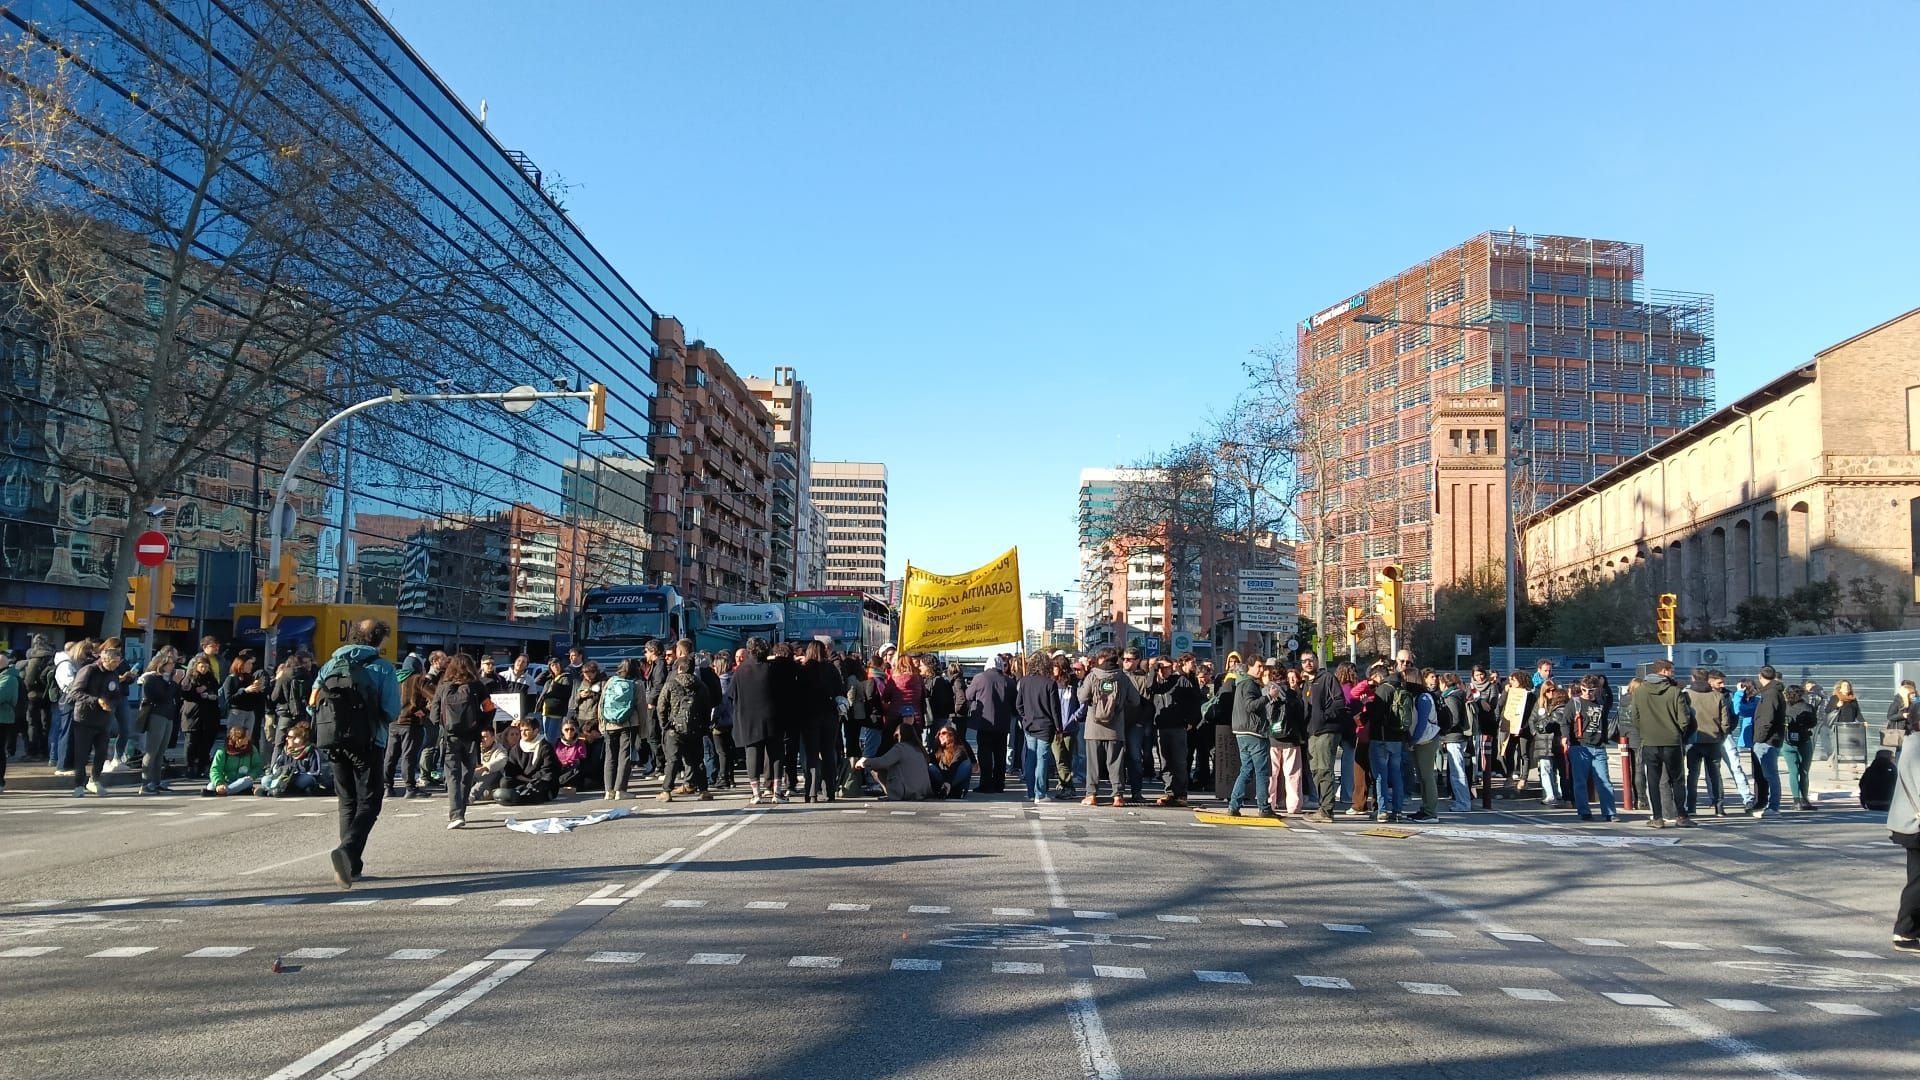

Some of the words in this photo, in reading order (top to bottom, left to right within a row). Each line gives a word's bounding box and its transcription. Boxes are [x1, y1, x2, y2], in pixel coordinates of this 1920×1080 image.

[605, 595, 643, 604] CHISPA
[52, 611, 72, 624] RACC
[165, 618, 180, 629] RACC
